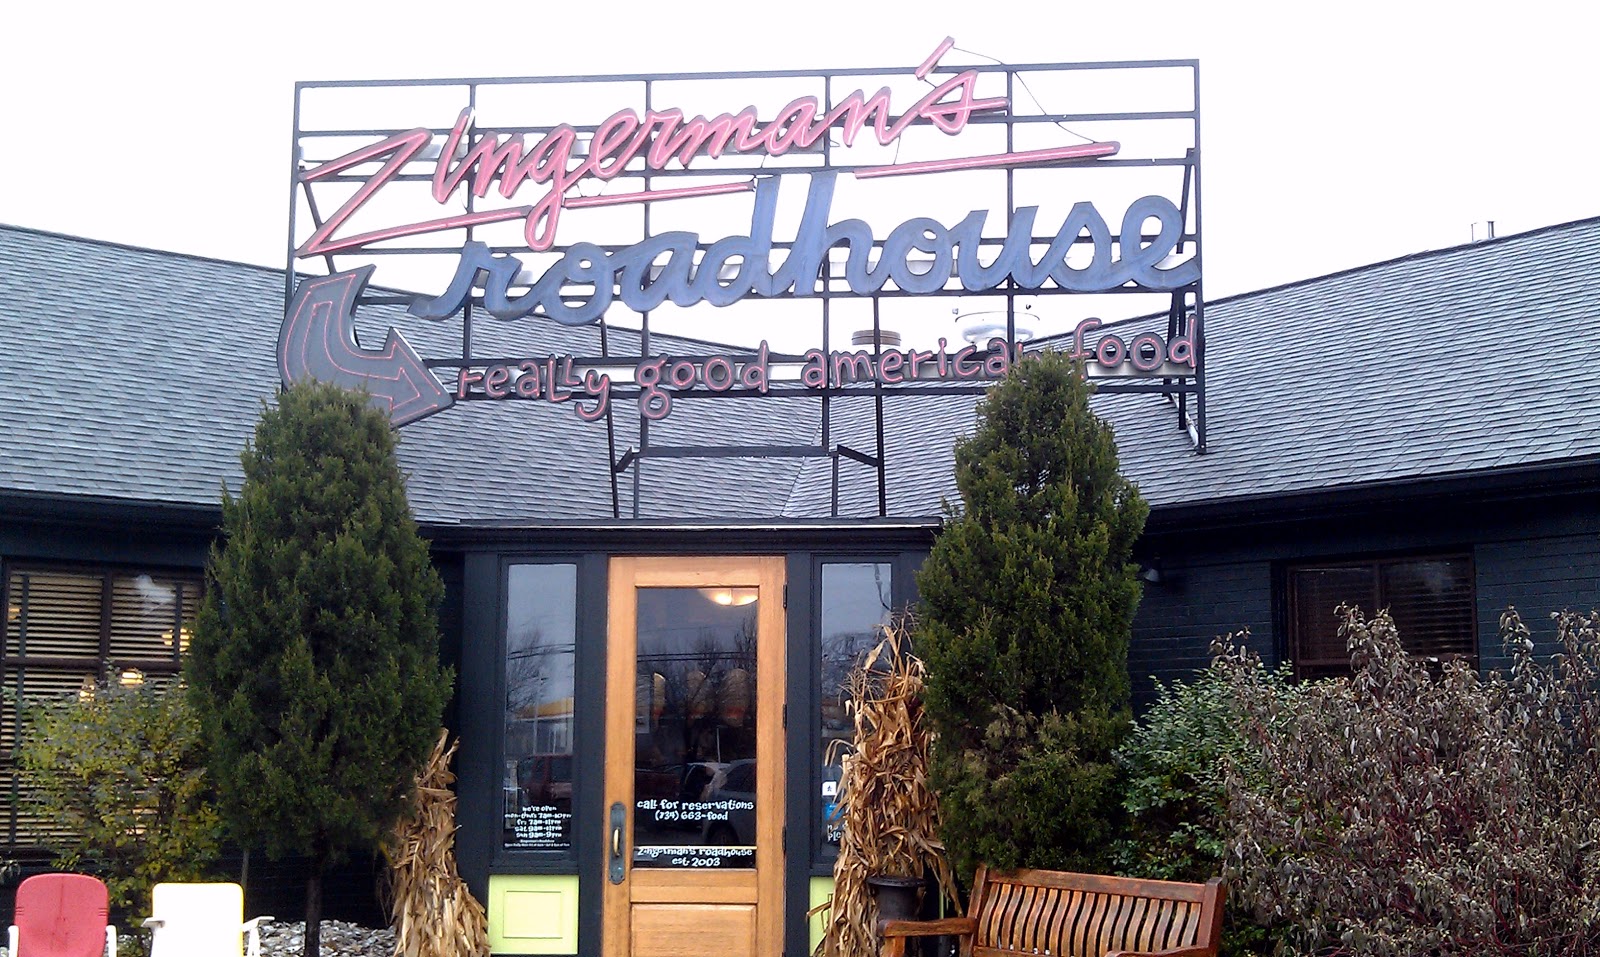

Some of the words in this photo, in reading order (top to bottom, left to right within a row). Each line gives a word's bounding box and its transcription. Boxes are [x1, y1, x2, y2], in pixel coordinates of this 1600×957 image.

[295, 36, 1010, 258] Zingerman's
[407, 170, 1202, 325] roadhouse
[634, 340, 770, 420] good
[1067, 314, 1198, 381] food
[655, 810, 679, 821] (734)
[681, 811, 728, 821] 663-food
[660, 799, 679, 810] for
[682, 799, 754, 811] reservations
[691, 857, 720, 867] 2003
